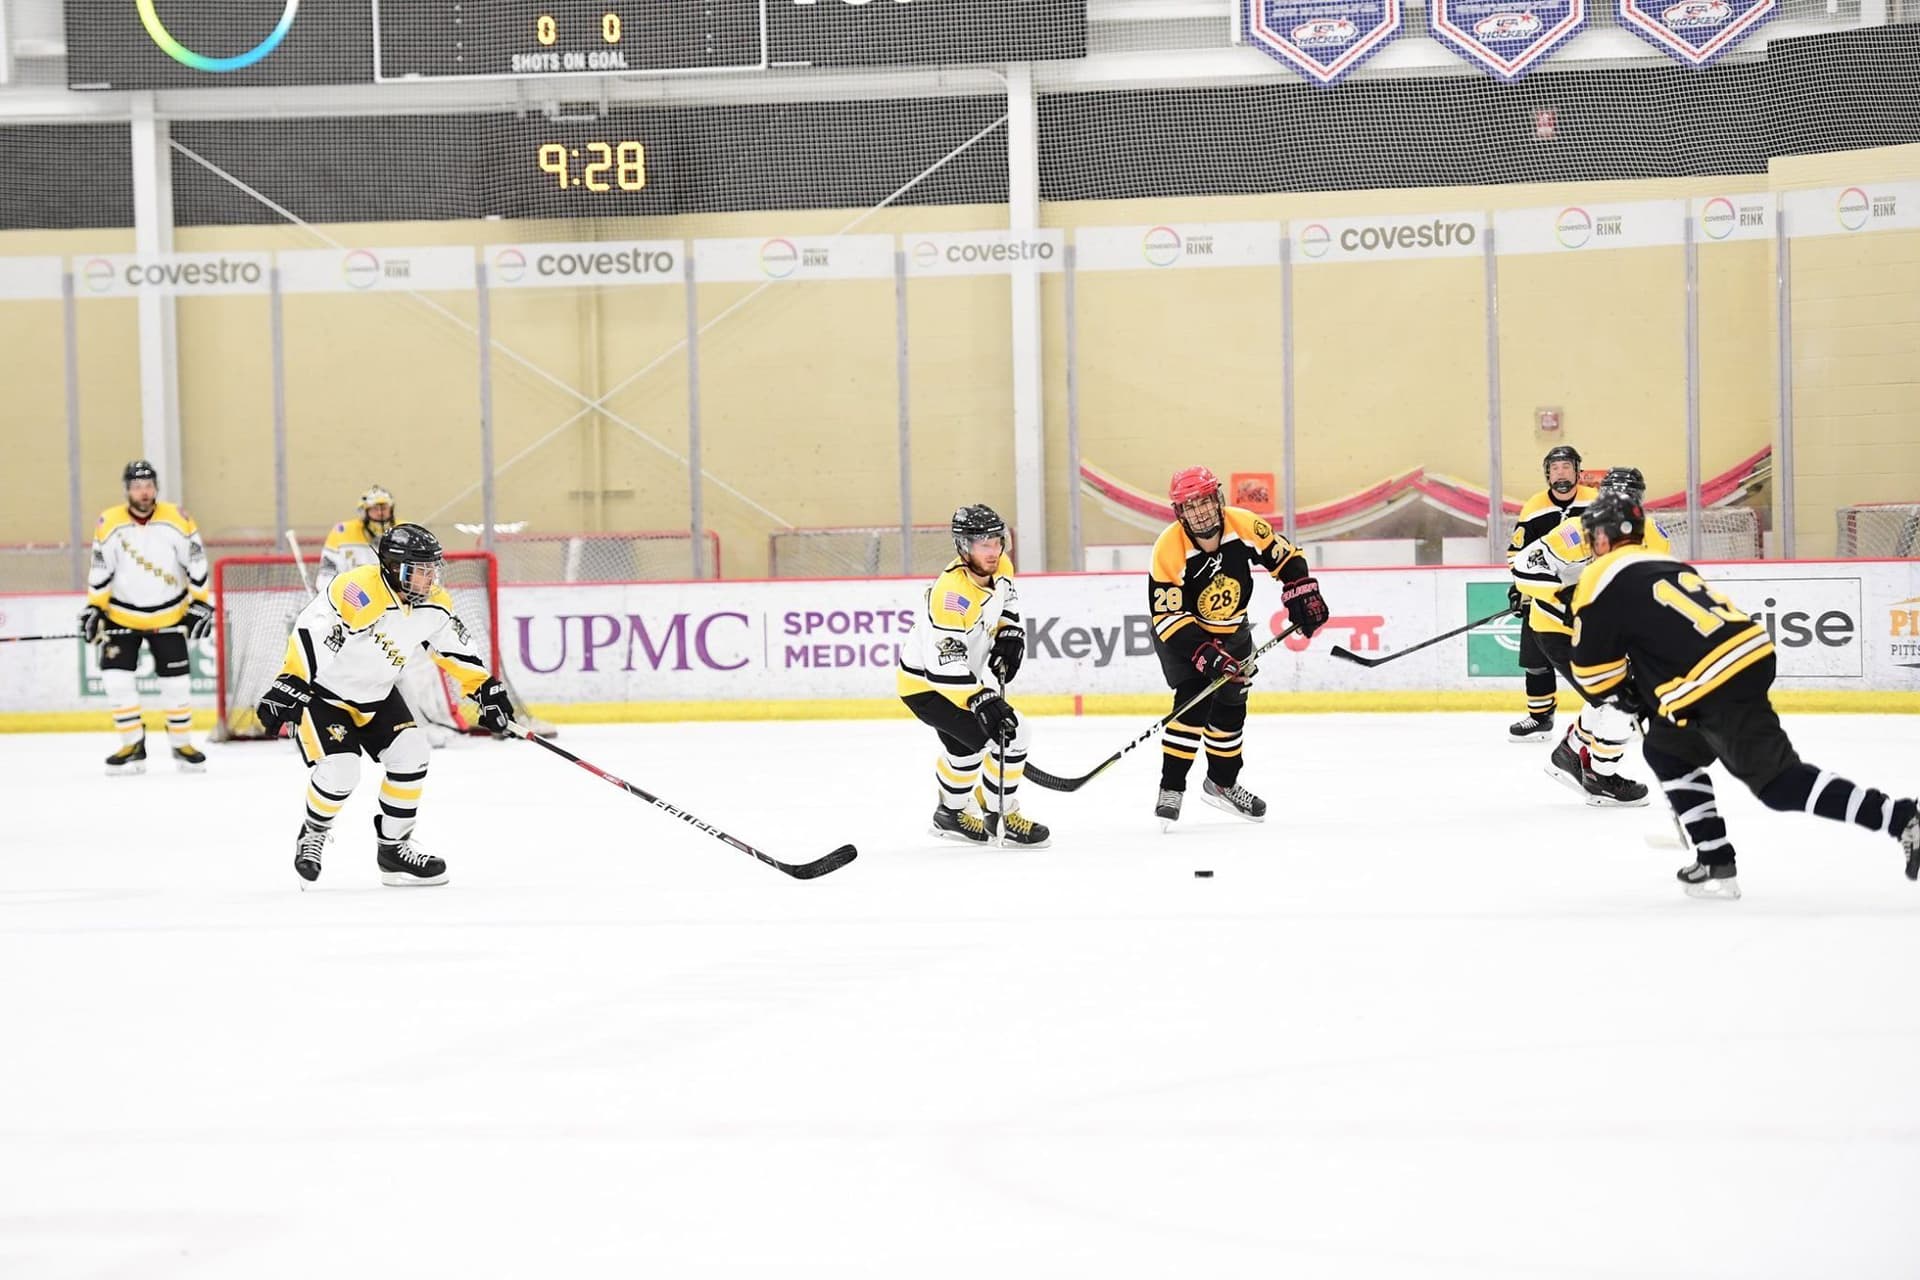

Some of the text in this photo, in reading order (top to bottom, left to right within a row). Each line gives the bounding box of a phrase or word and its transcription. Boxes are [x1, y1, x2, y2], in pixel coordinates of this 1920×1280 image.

[511, 51, 628, 71] SHOTS ON GOAL
[539, 141, 646, 191] 9:28
[1740, 213, 1764, 226] RINK
[1873, 203, 1896, 217] RINK
[1340, 219, 1476, 251] covestro
[1597, 222, 1622, 236] RINK
[946, 240, 1055, 262] covestro
[1186, 242, 1214, 255] RINK
[125, 258, 262, 285] covestro
[536, 247, 674, 276] covestro
[1153, 586, 1183, 613] 28
[1209, 588, 1233, 612] 28
[1652, 571, 1750, 637] 13
[783, 610, 916, 635] SPORTS
[513, 611, 751, 674] UPMC
[784, 643, 901, 669] MEDICI
